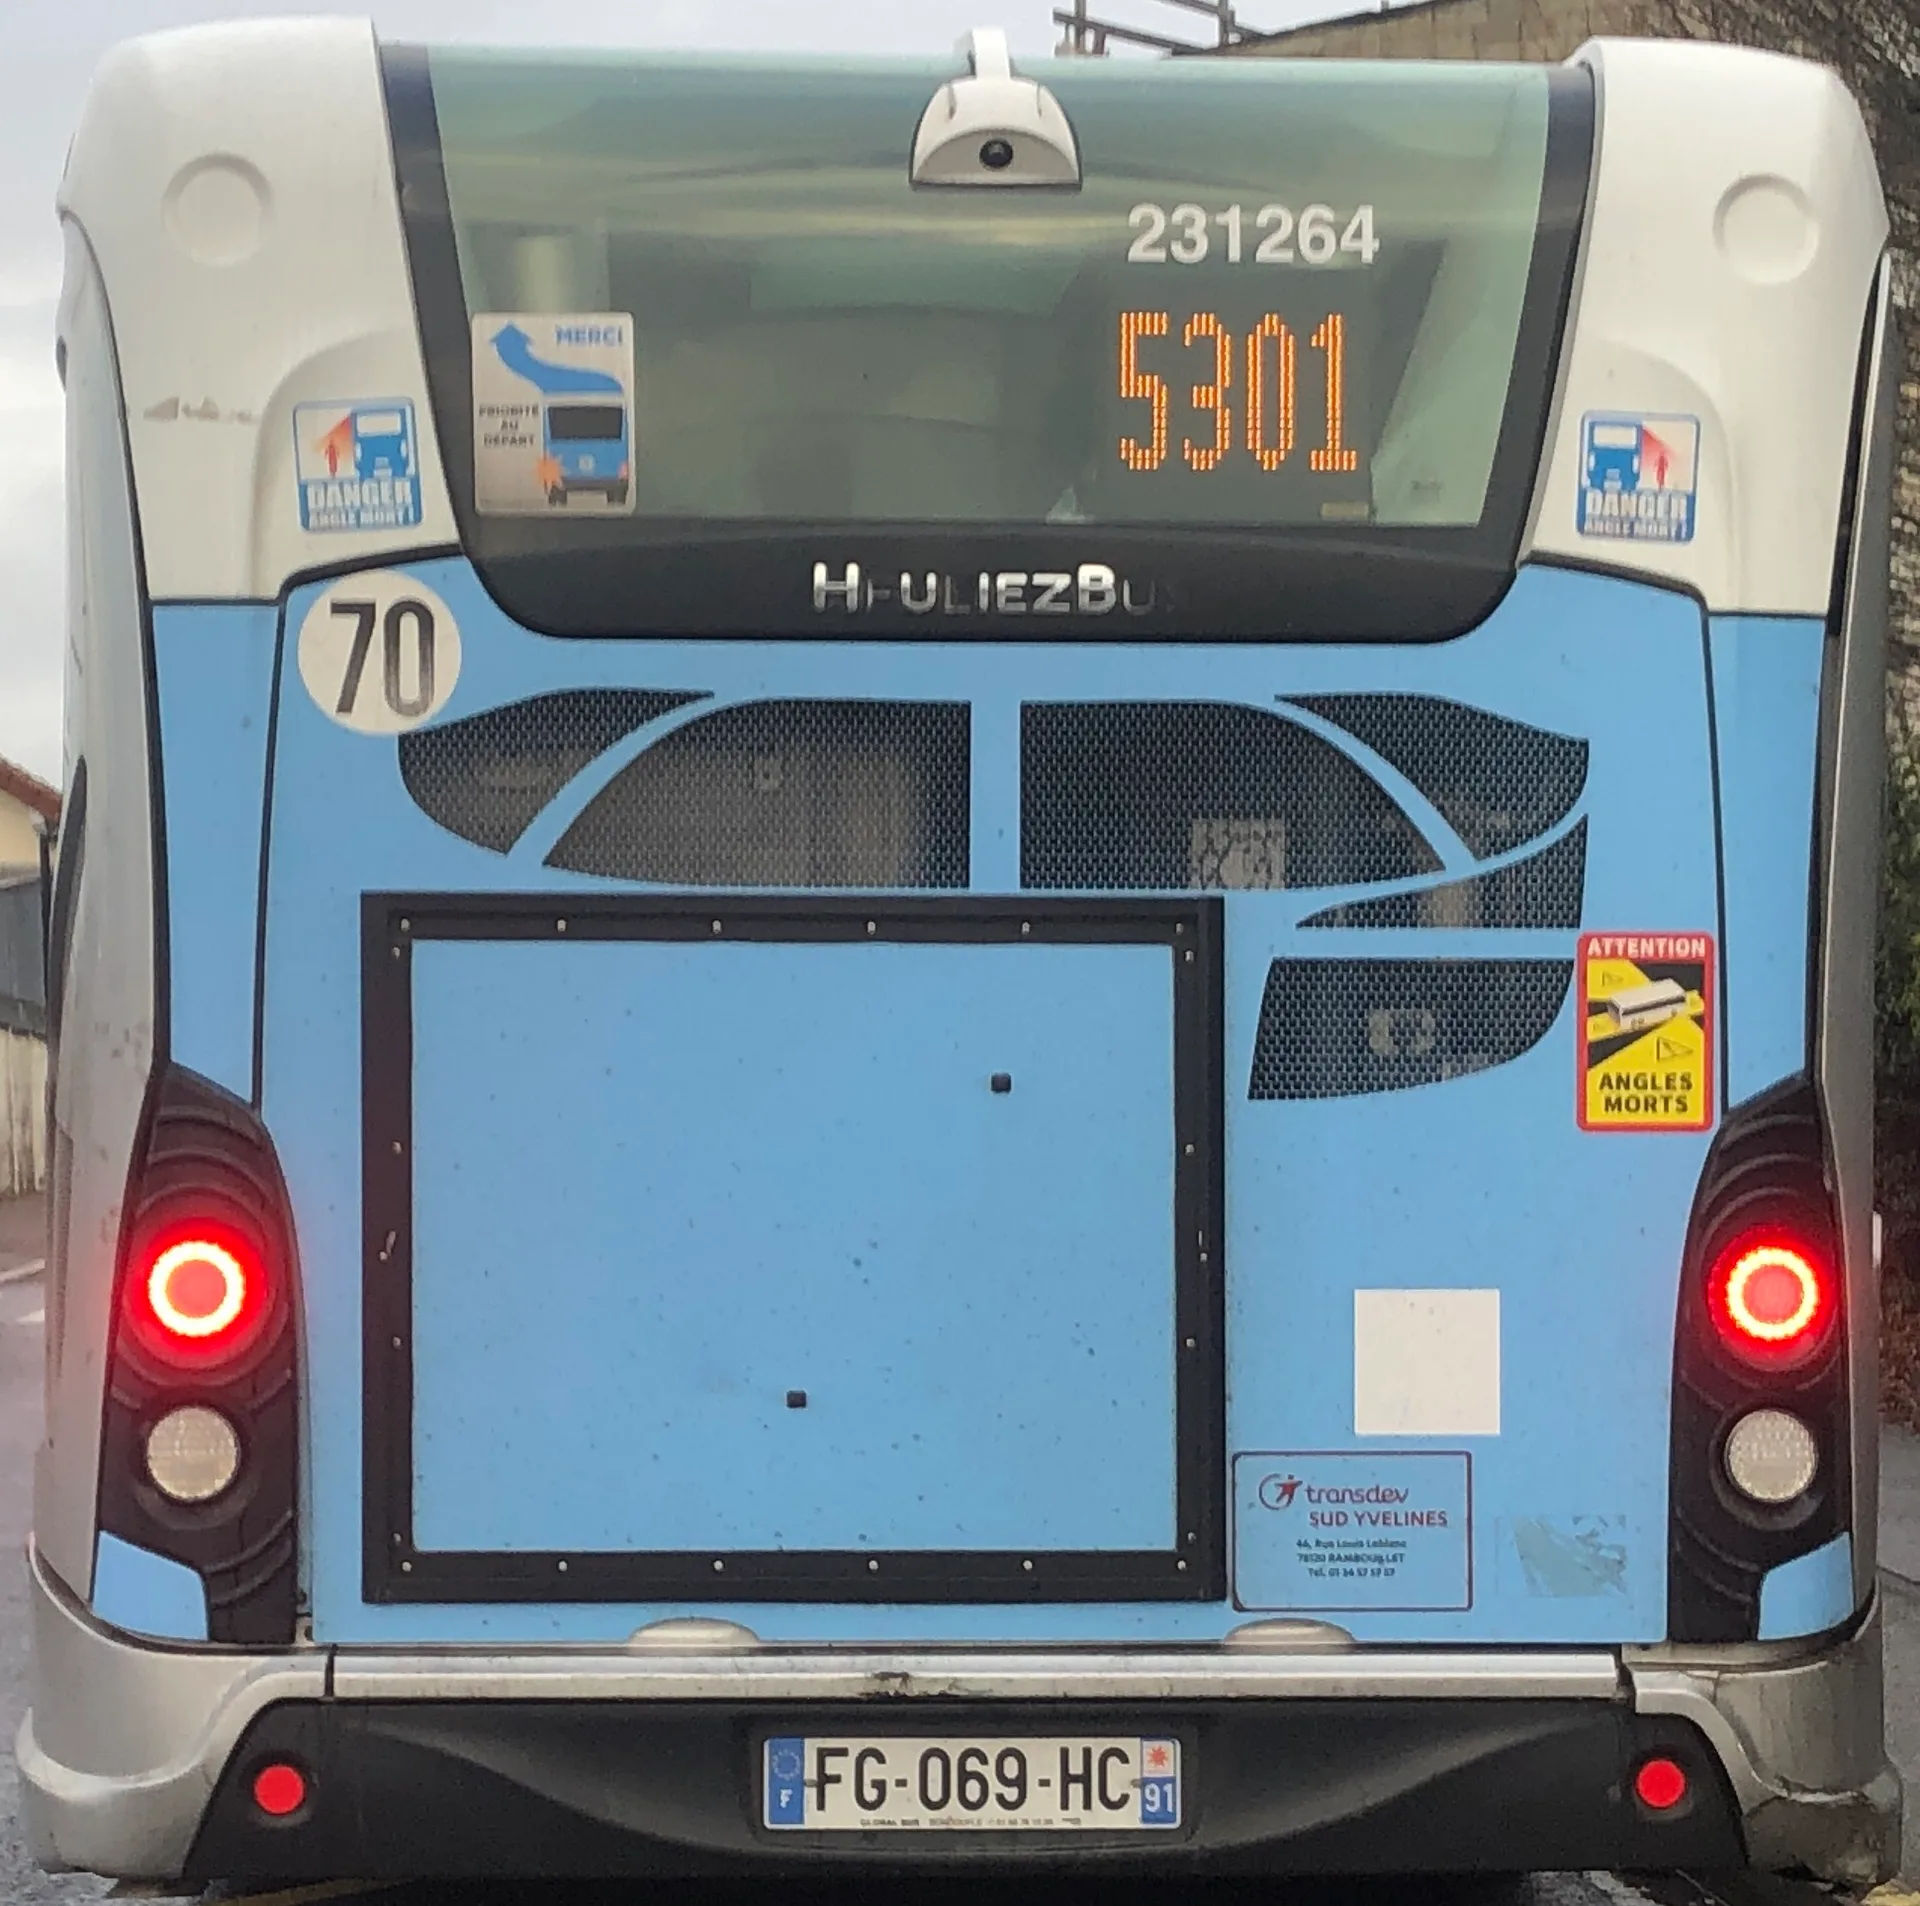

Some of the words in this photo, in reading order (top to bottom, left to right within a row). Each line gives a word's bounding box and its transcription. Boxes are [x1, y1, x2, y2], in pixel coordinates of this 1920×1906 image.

[1127, 203, 1380, 264] 231264
[555, 326, 623, 346] MERCI
[1120, 312, 1358, 471] 5301
[501, 419, 518, 430] AU
[307, 480, 412, 509] DANGER
[1586, 491, 1687, 519] DANGER
[813, 562, 1172, 615] HULIEZBU
[331, 601, 434, 717] 70
[1587, 937, 1706, 959] ATTENTION
[1599, 1072, 1693, 1092] ANGLES
[1604, 1095, 1688, 1114] MORTS
[1305, 1484, 1409, 1504] transdev
[1309, 1510, 1348, 1528] SUD
[1354, 1510, 1448, 1528] YVELINES
[815, 1746, 1131, 1811] FG-069-HC
[780, 1788, 793, 1809] F
[1144, 1783, 1173, 1813] 91
